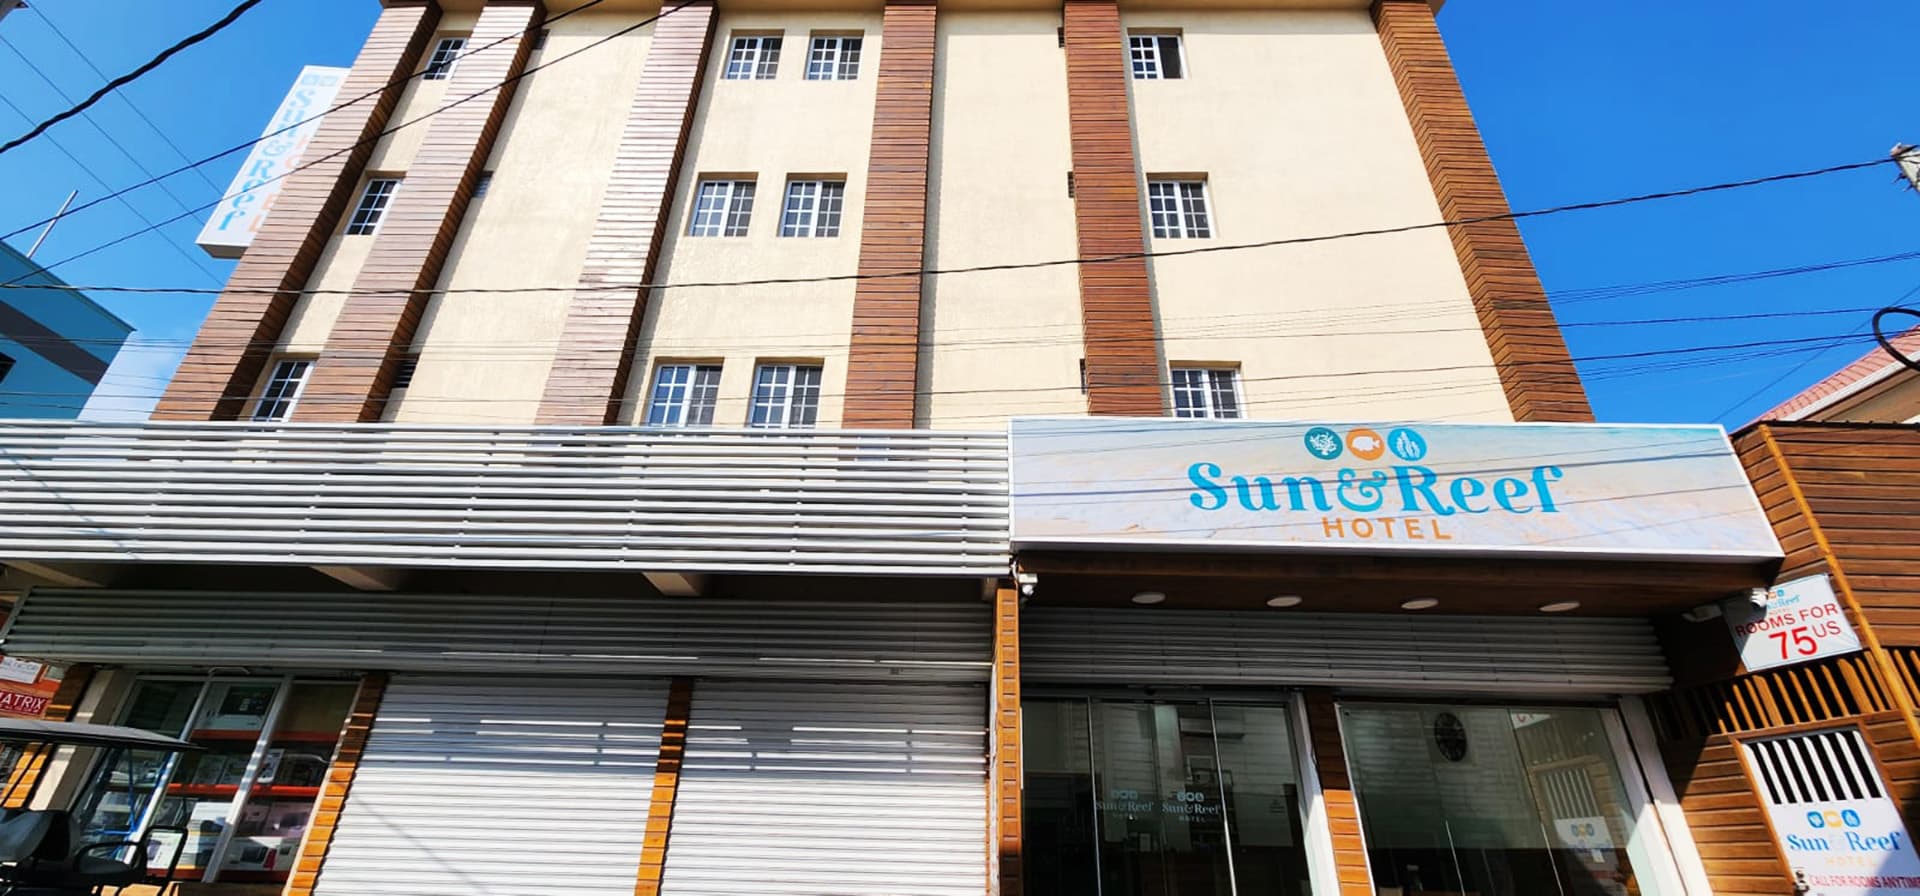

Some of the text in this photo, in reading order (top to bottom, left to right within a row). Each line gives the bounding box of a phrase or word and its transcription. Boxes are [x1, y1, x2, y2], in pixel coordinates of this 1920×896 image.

[1187, 462, 1564, 516] Sun&Reef
[1322, 516, 1452, 541] HOTEL
[1735, 603, 1838, 636] ROOMS FOR
[1768, 620, 1841, 660] 75 US
[1845, 831, 1901, 851] Reef
